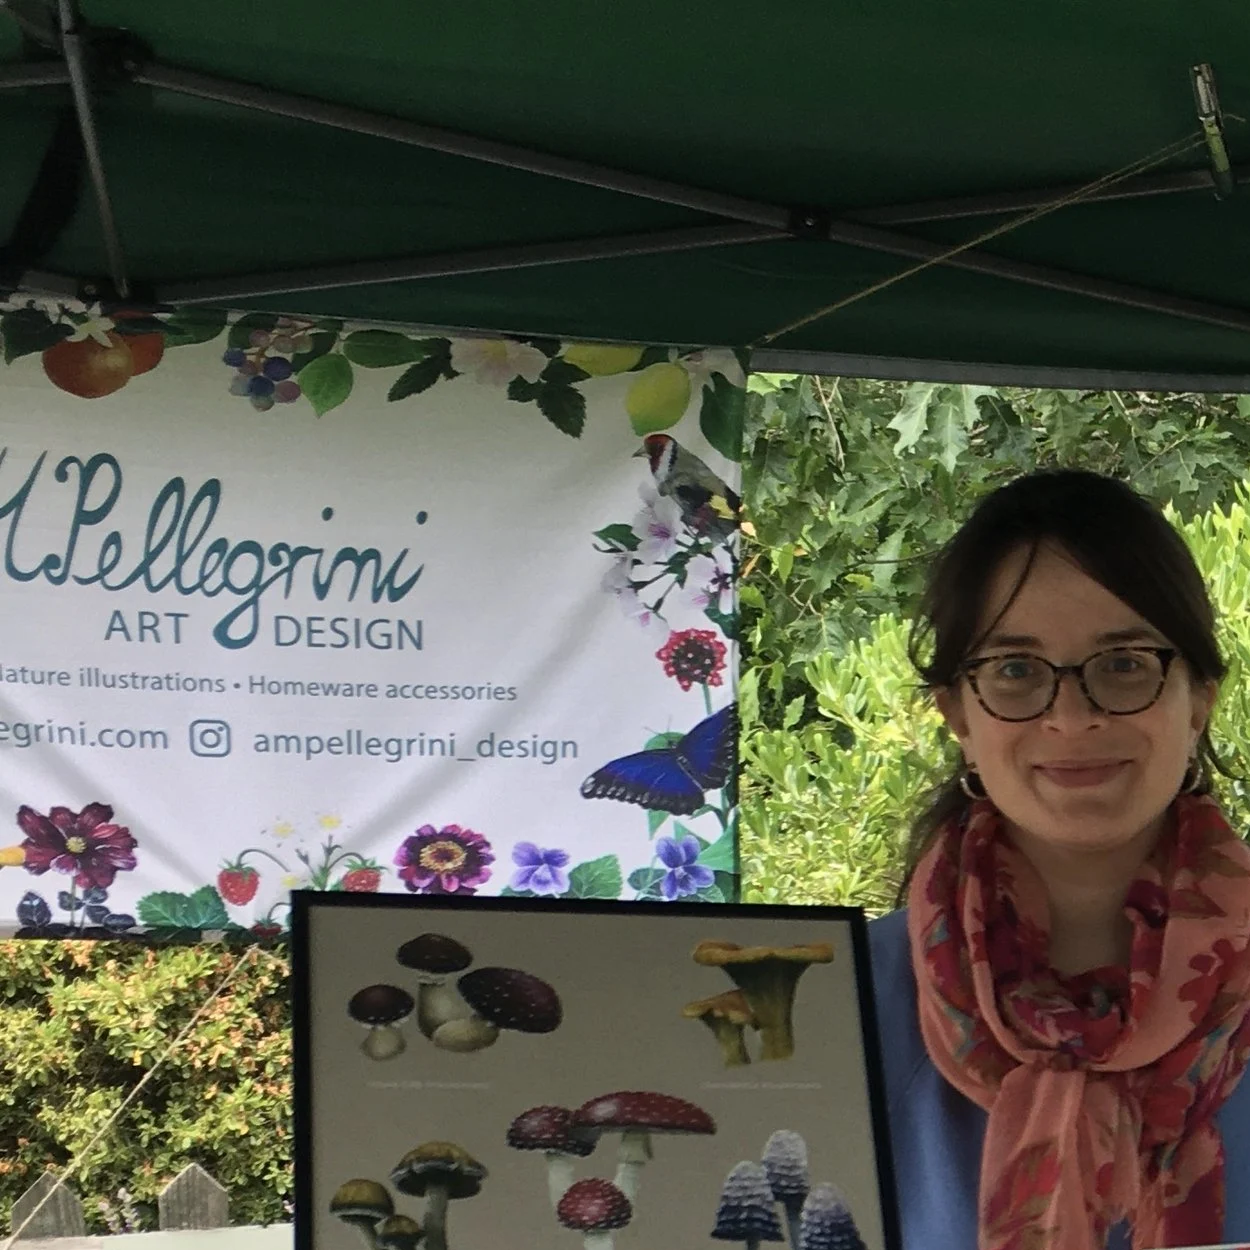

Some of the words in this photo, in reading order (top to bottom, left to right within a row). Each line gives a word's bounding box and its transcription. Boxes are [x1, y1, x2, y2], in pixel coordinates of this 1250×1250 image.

[104, 609, 190, 644] ART
[273, 614, 424, 651] DESIGN
[0, 664, 72, 687] ature
[79, 667, 227, 694] illustrations
[248, 675, 379, 699] Homeware
[385, 681, 518, 702] accessories
[253, 729, 579, 765] ampellegrini_design
